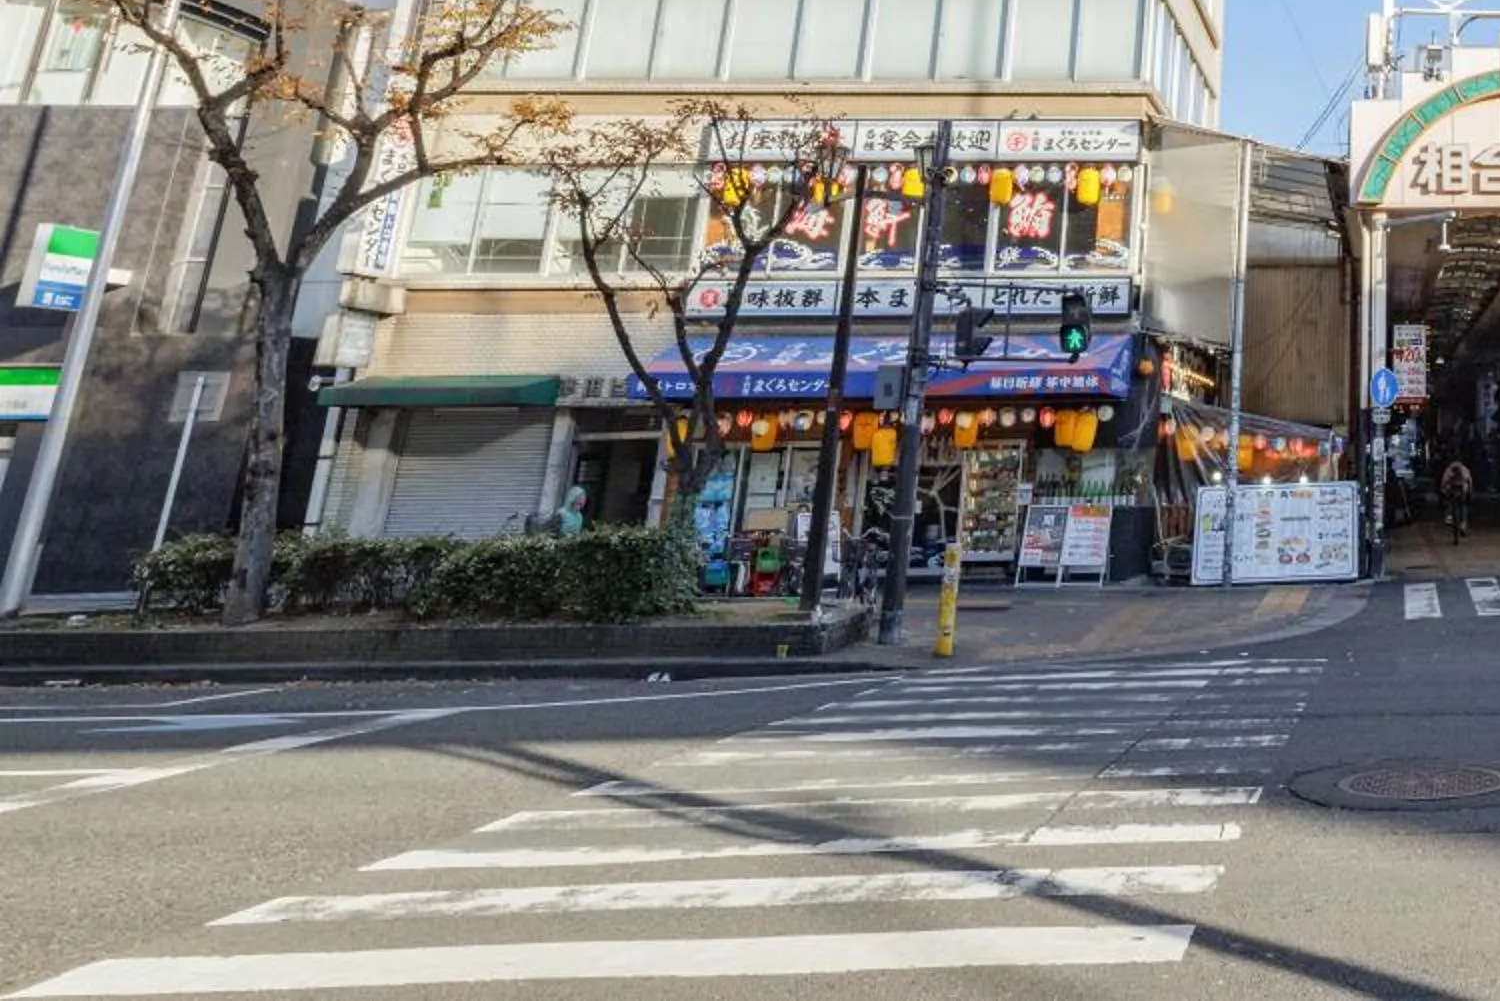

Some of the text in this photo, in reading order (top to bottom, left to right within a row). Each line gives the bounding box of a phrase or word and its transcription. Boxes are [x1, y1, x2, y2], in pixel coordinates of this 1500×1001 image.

[728, 288, 825, 309] 味抜群
[856, 284, 969, 309] 本まろ
